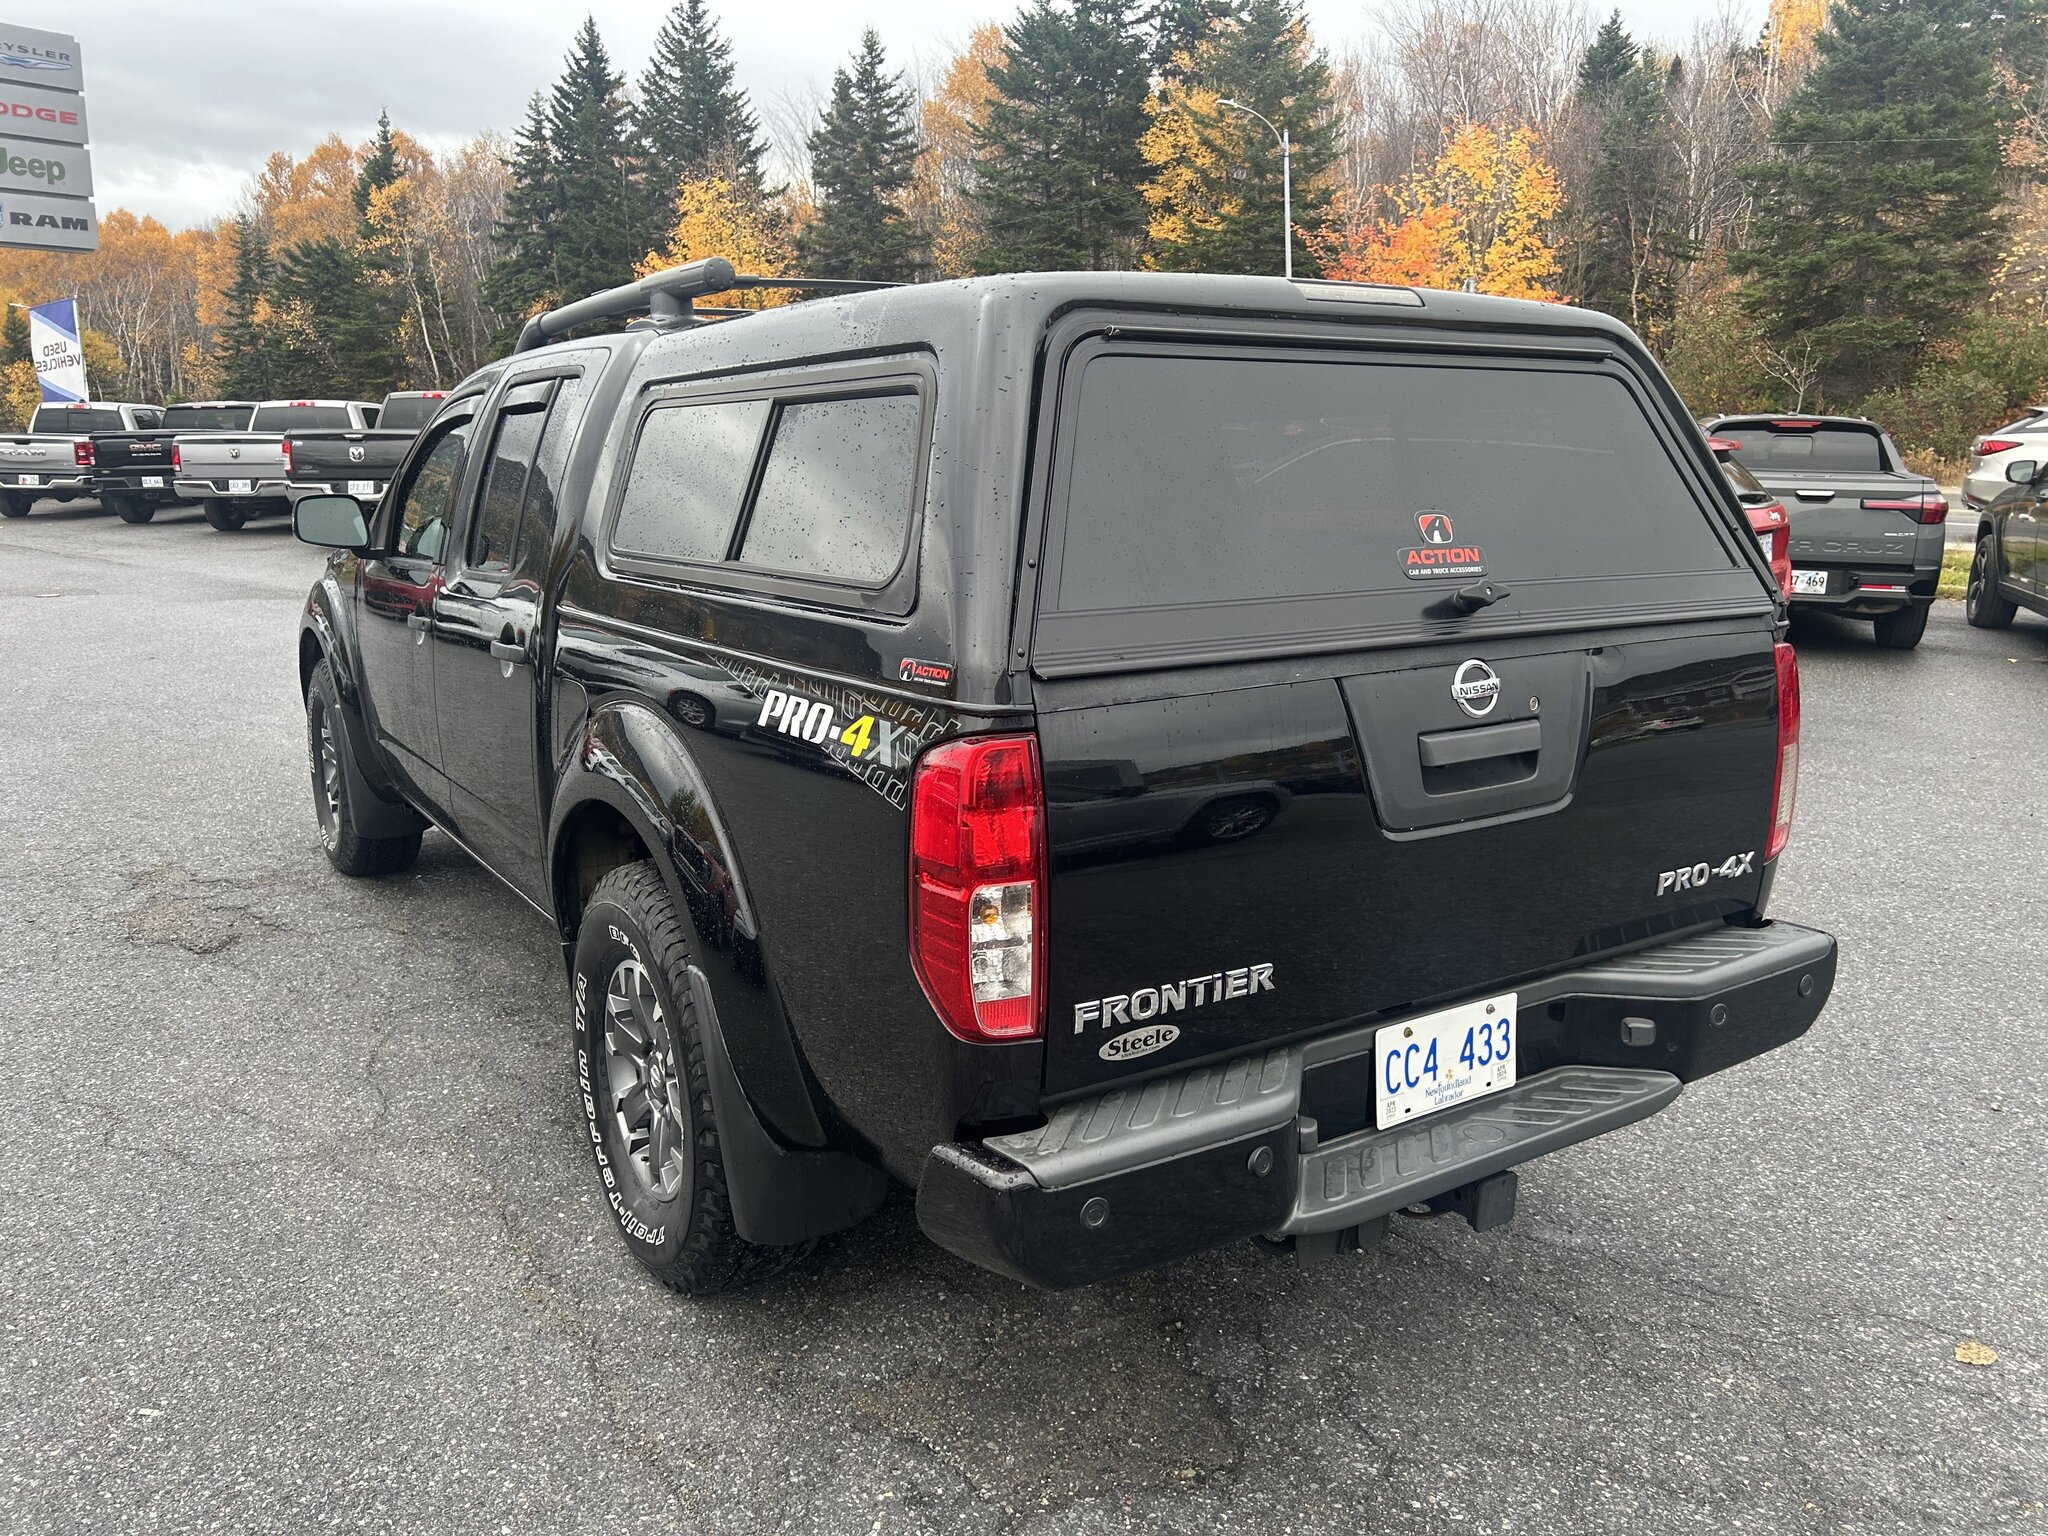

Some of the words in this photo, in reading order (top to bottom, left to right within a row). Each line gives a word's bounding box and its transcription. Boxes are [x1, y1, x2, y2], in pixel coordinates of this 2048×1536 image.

[10, 212, 89, 231] RAM
[0, 448, 47, 457] RAM
[129, 443, 161, 452] GMC
[1822, 541, 1904, 555] CRUZ
[1407, 548, 1480, 565] ACTION
[1450, 566, 1482, 574] ACCESSORIES
[1805, 576, 1825, 587] 469
[915, 665, 950, 681] ACTION
[1459, 682, 1499, 696] NISSAN
[757, 689, 907, 769] PRO-4X
[1656, 850, 1755, 897] PRO-4X
[1073, 962, 1276, 1035] FRONTIER
[1107, 1028, 1174, 1057] Steele
[1385, 1037, 1439, 1094] CC4
[1459, 1018, 1511, 1070] 433
[1425, 1075, 1472, 1098] Newfoundland
[1434, 1090, 1465, 1105] Labrador
